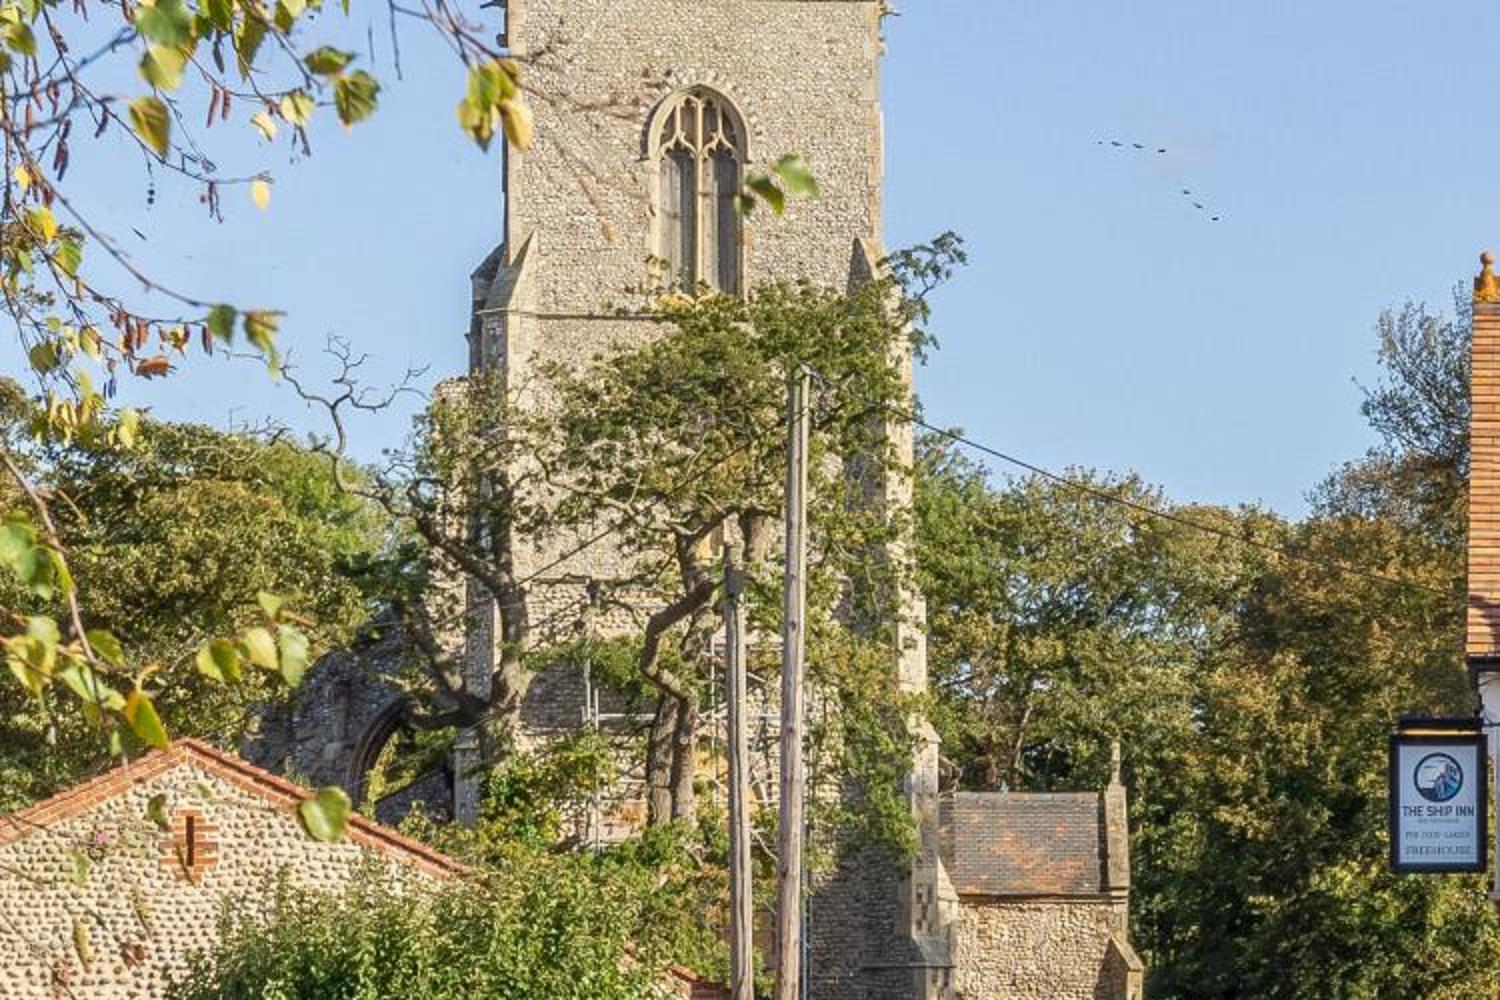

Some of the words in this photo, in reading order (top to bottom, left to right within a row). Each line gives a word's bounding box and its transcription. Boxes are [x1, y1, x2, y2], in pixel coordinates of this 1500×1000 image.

[1402, 805, 1425, 817] THE
[1427, 805, 1453, 817] SHIP
[1456, 805, 1474, 817] INN
